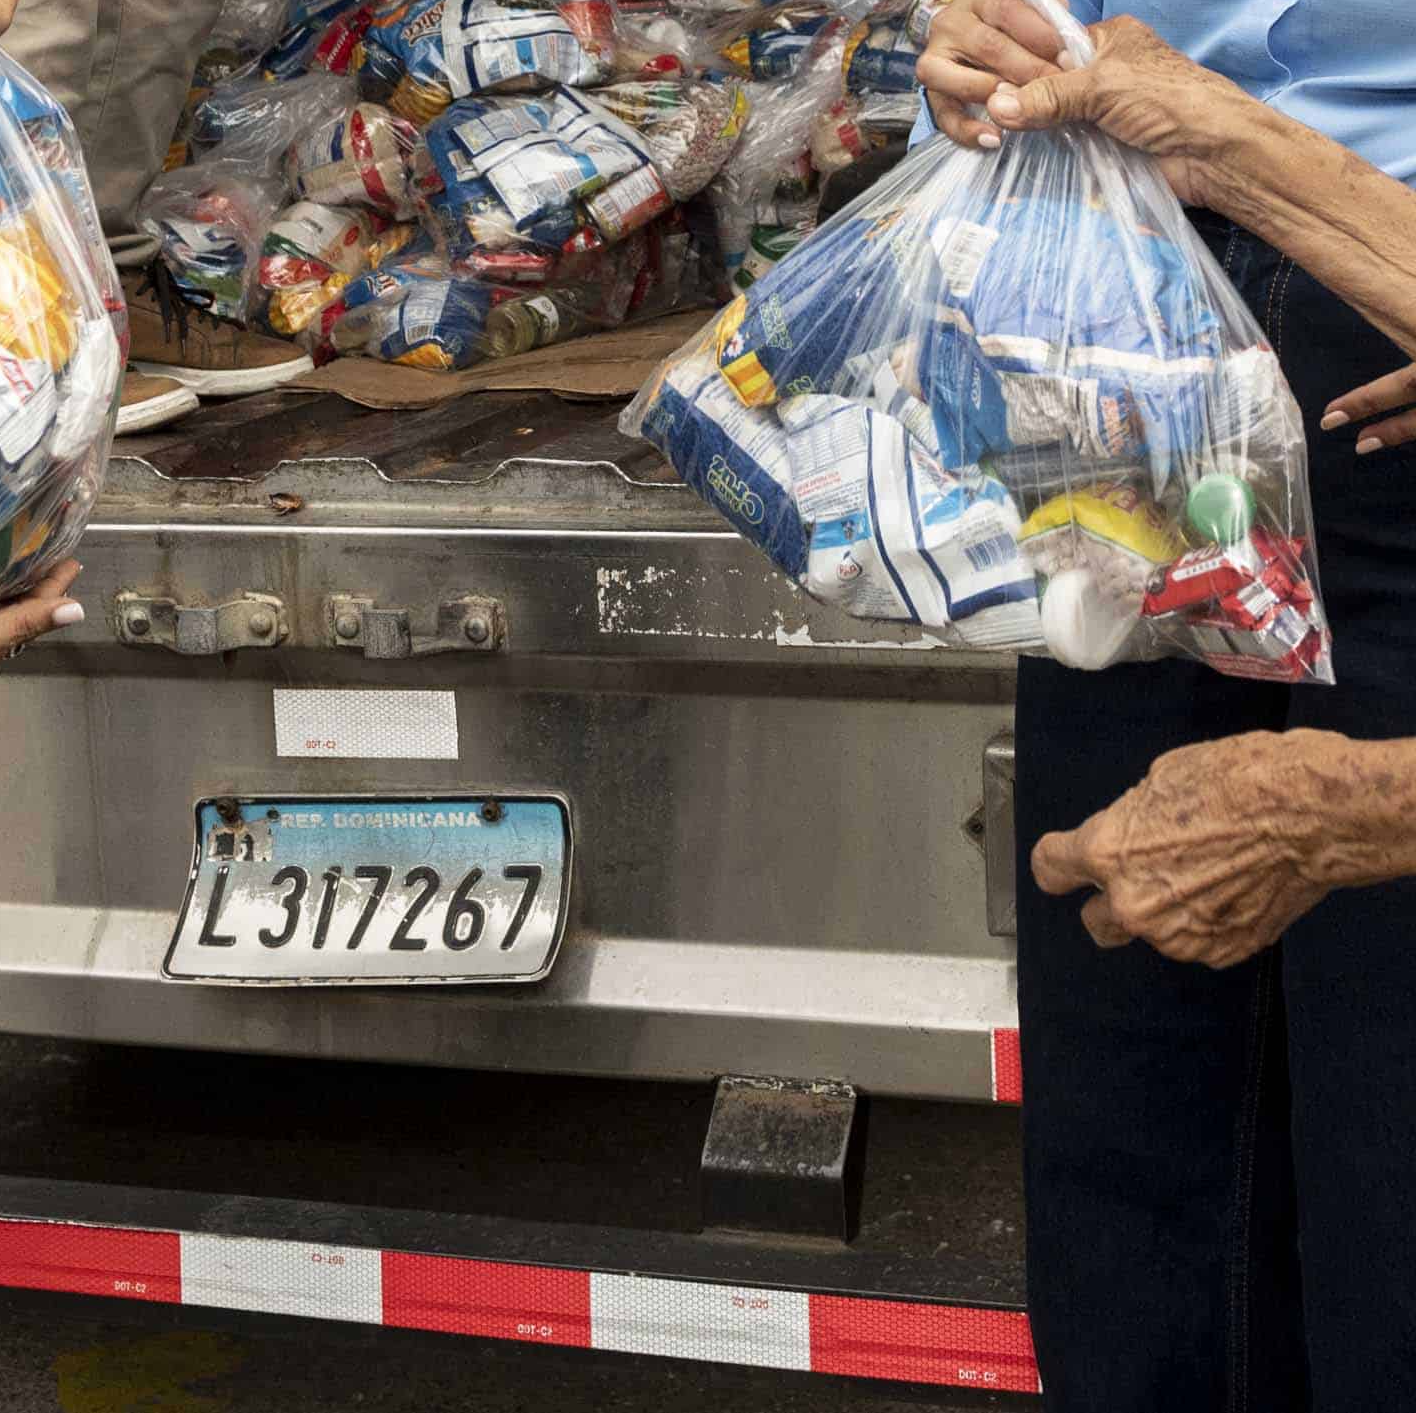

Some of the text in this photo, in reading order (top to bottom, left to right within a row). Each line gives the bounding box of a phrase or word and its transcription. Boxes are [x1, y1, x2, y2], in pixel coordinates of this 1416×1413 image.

[333, 811, 483, 829] DOMINICANA
[197, 864, 545, 952] L317267
[114, 1280, 146, 1293] DOT-C2
